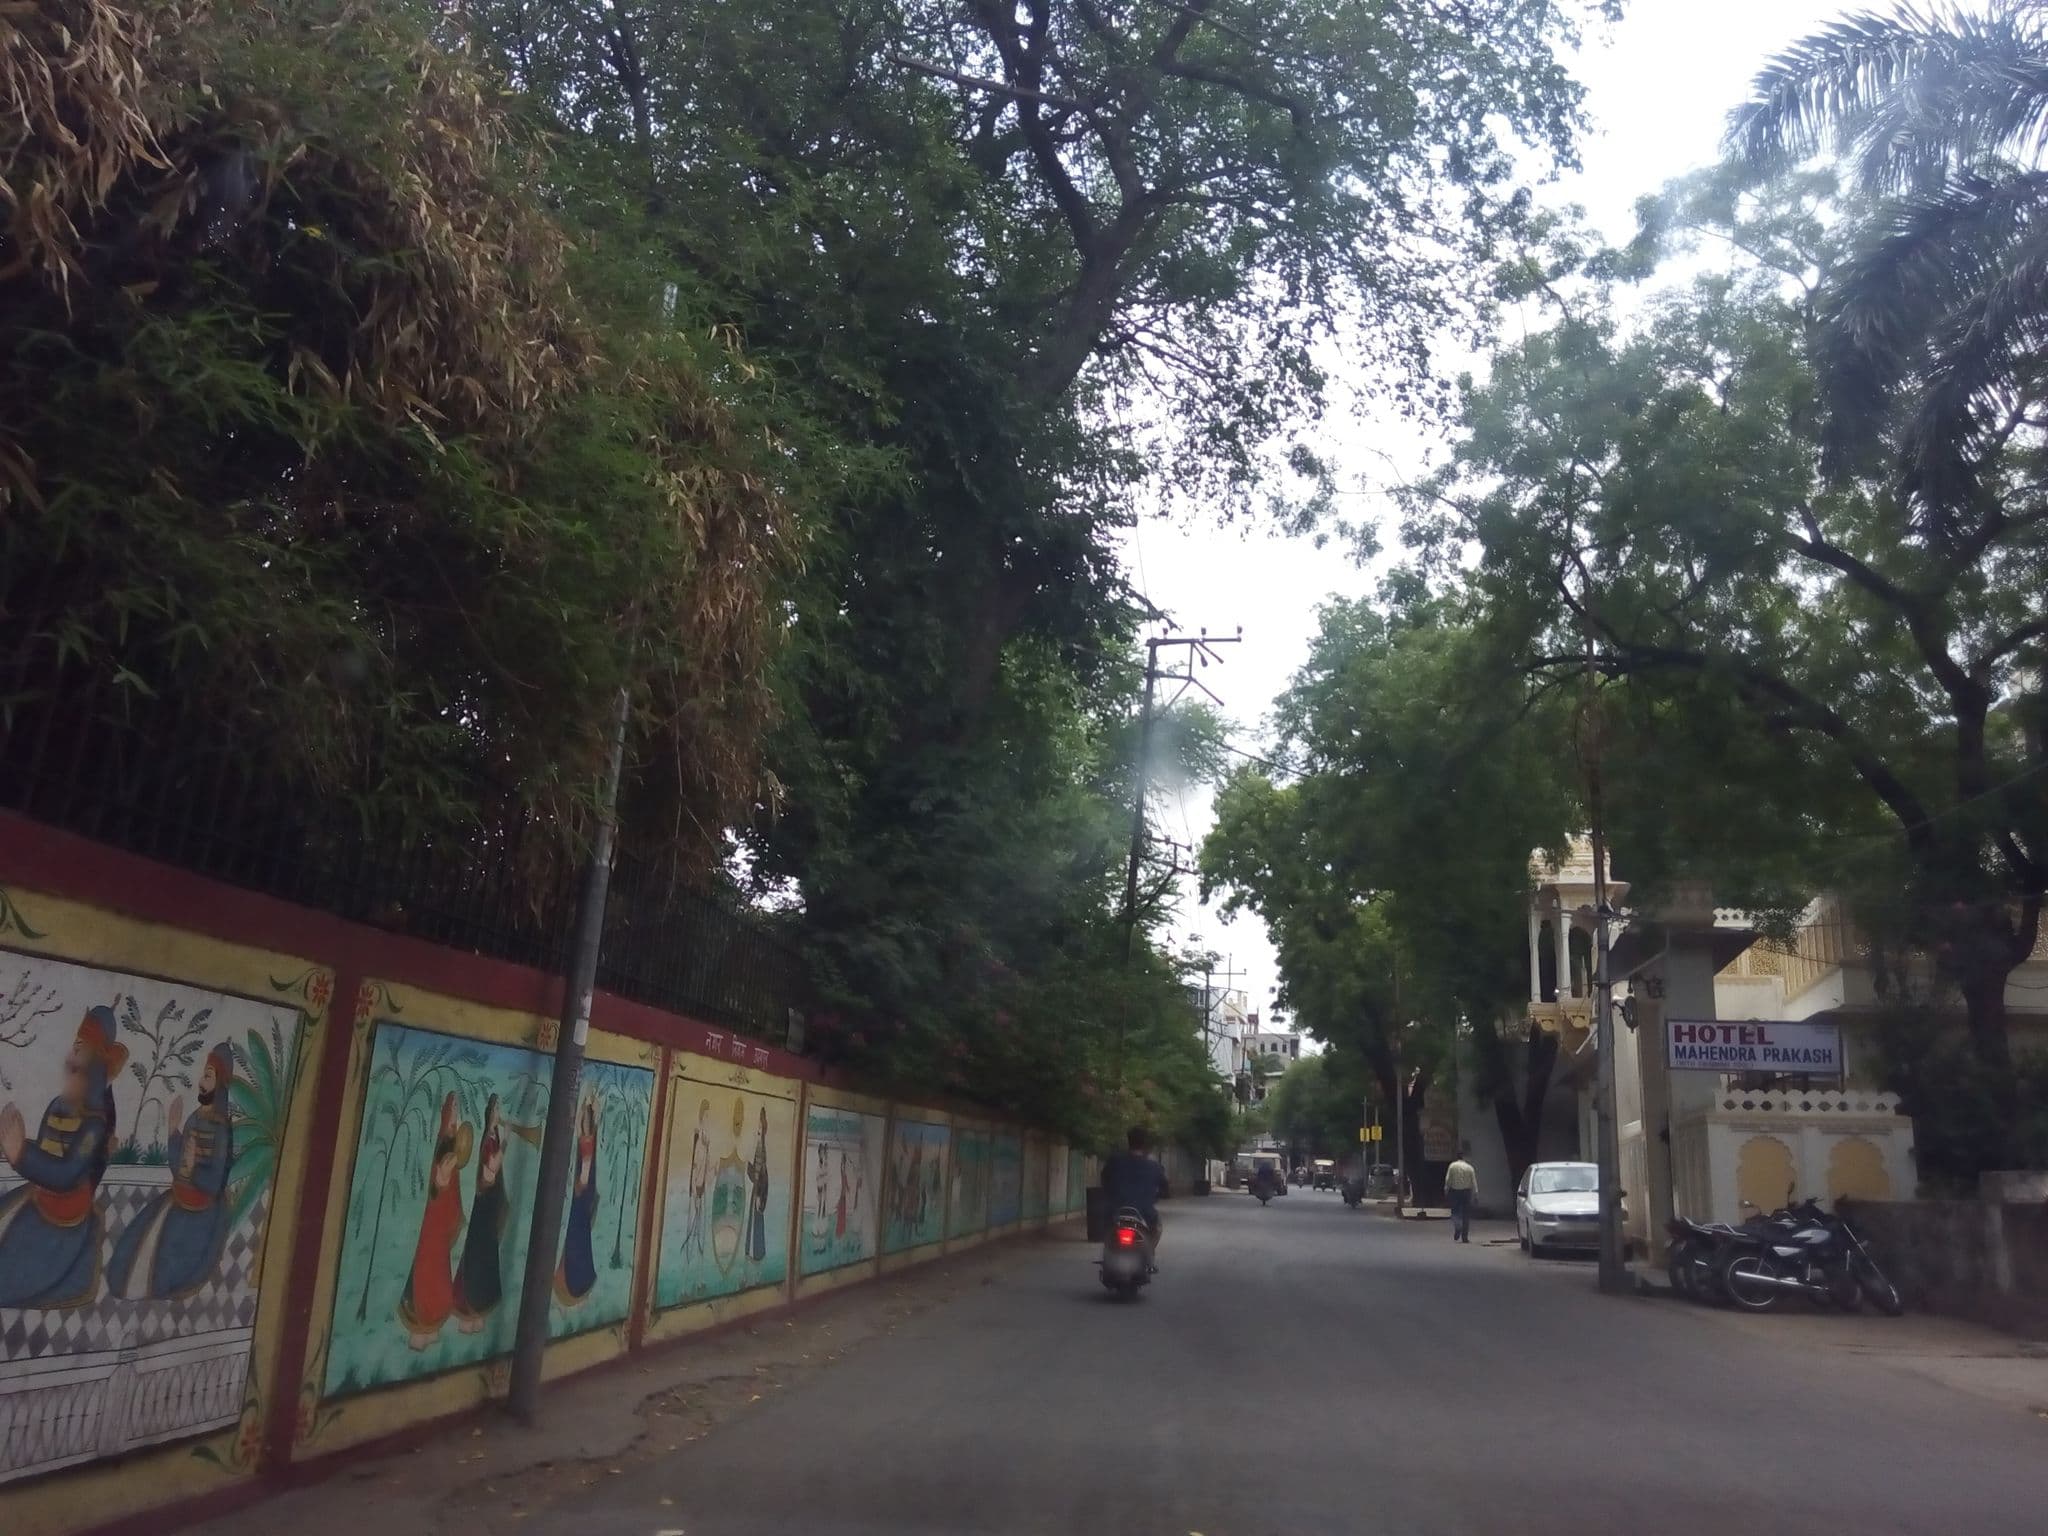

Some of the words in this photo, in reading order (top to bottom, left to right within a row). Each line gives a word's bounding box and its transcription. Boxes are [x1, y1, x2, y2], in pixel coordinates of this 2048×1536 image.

[1674, 1024, 1774, 1045] HOTEL
[1675, 1045, 1757, 1062] MAHENDRA
[1763, 1047, 1832, 1065] PRAKASH
